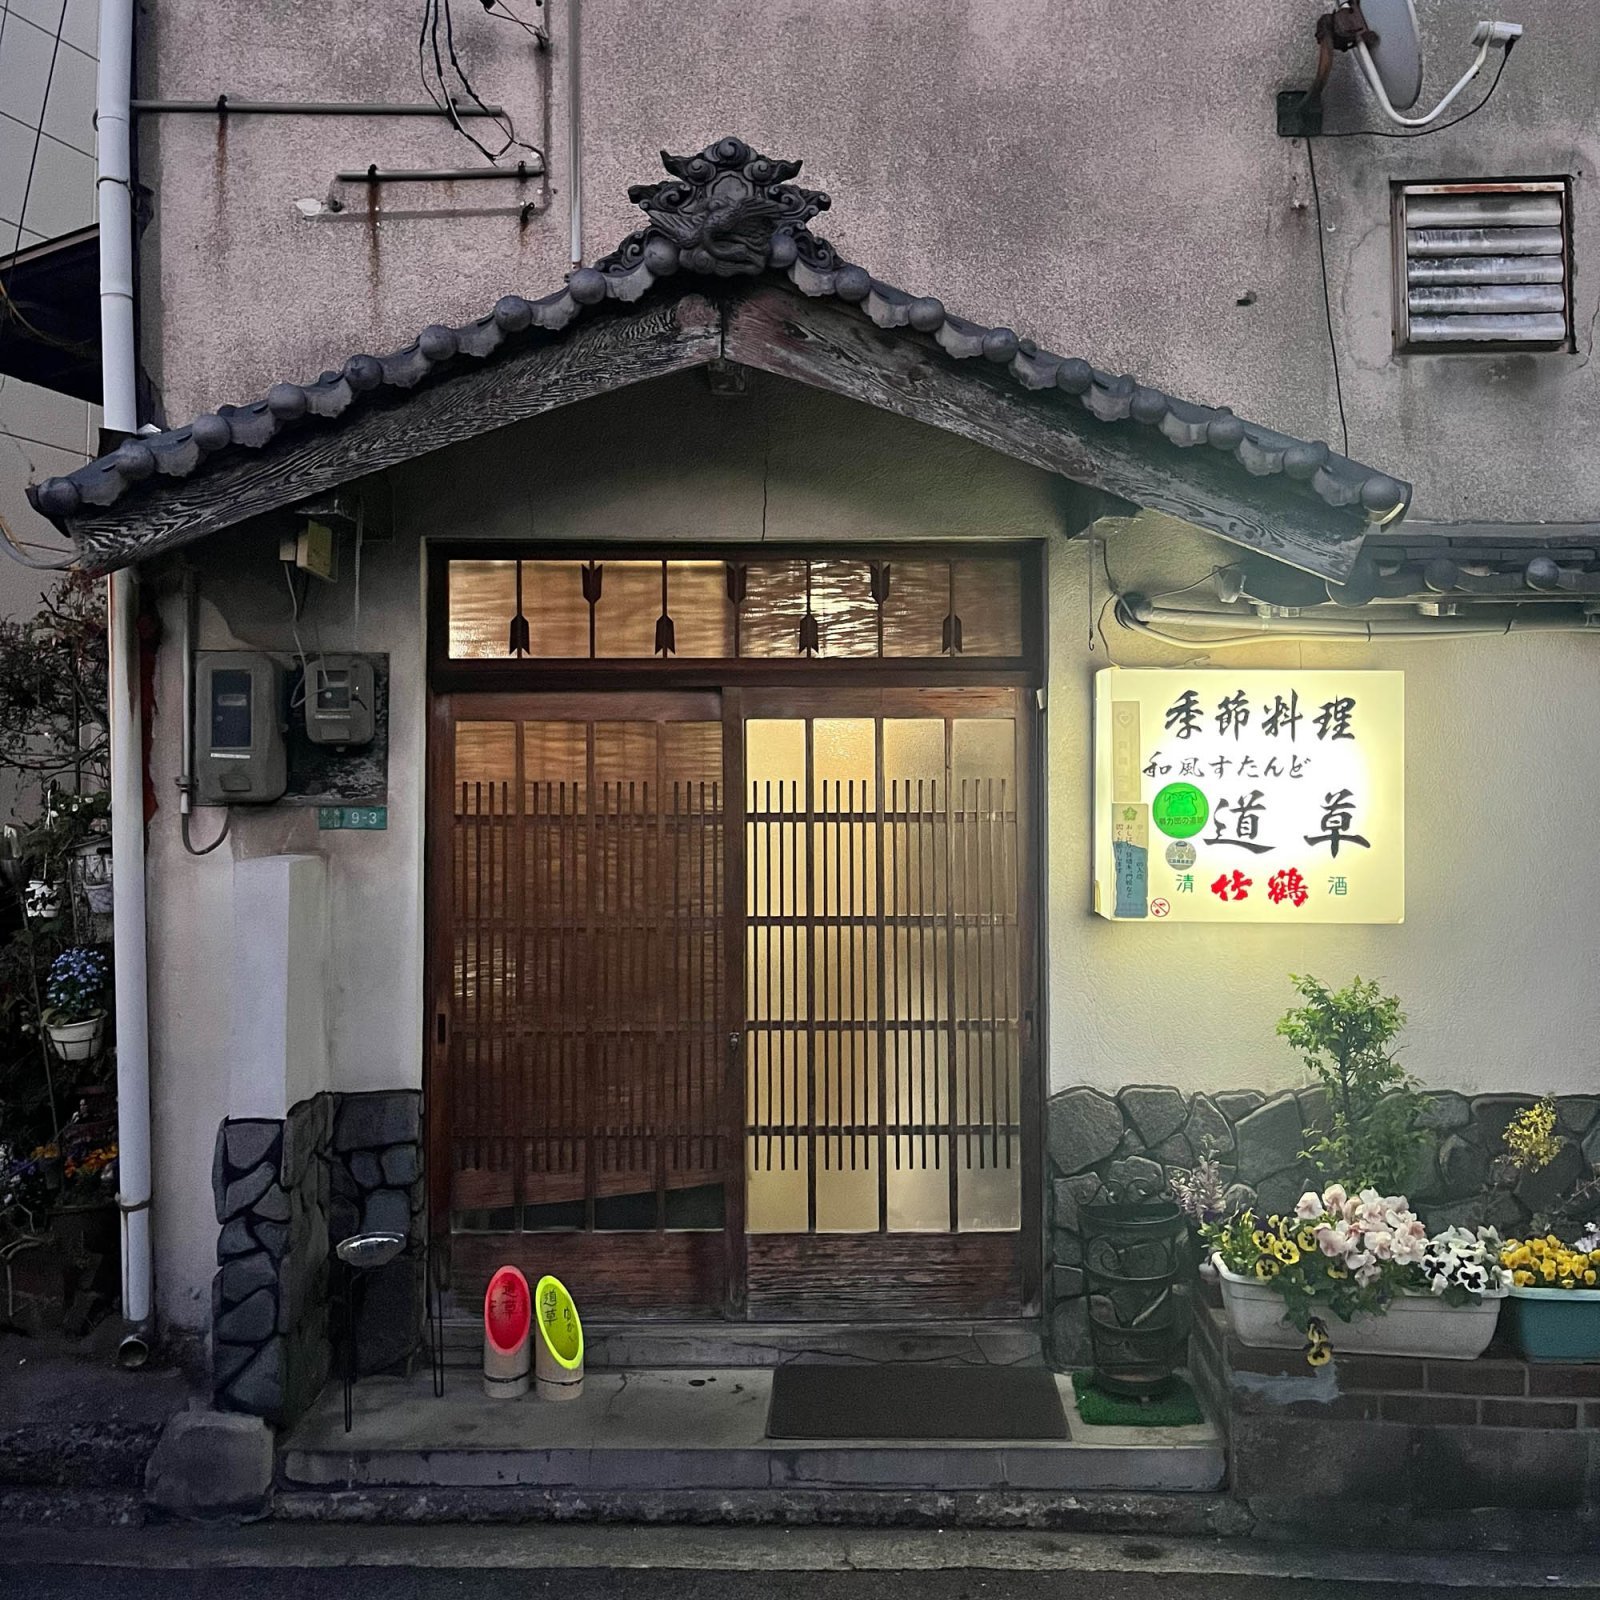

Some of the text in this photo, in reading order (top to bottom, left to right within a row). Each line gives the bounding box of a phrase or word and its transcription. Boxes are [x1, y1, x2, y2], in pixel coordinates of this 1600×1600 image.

[1164, 688, 1357, 742] 季節料理
[1142, 751, 1311, 779] 和風すたんど
[351, 811, 377, 825] 9-3
[1203, 788, 1371, 859] 道草
[1175, 867, 1348, 907] 清 竹鶴 酒
[543, 1288, 558, 1327] 道草
